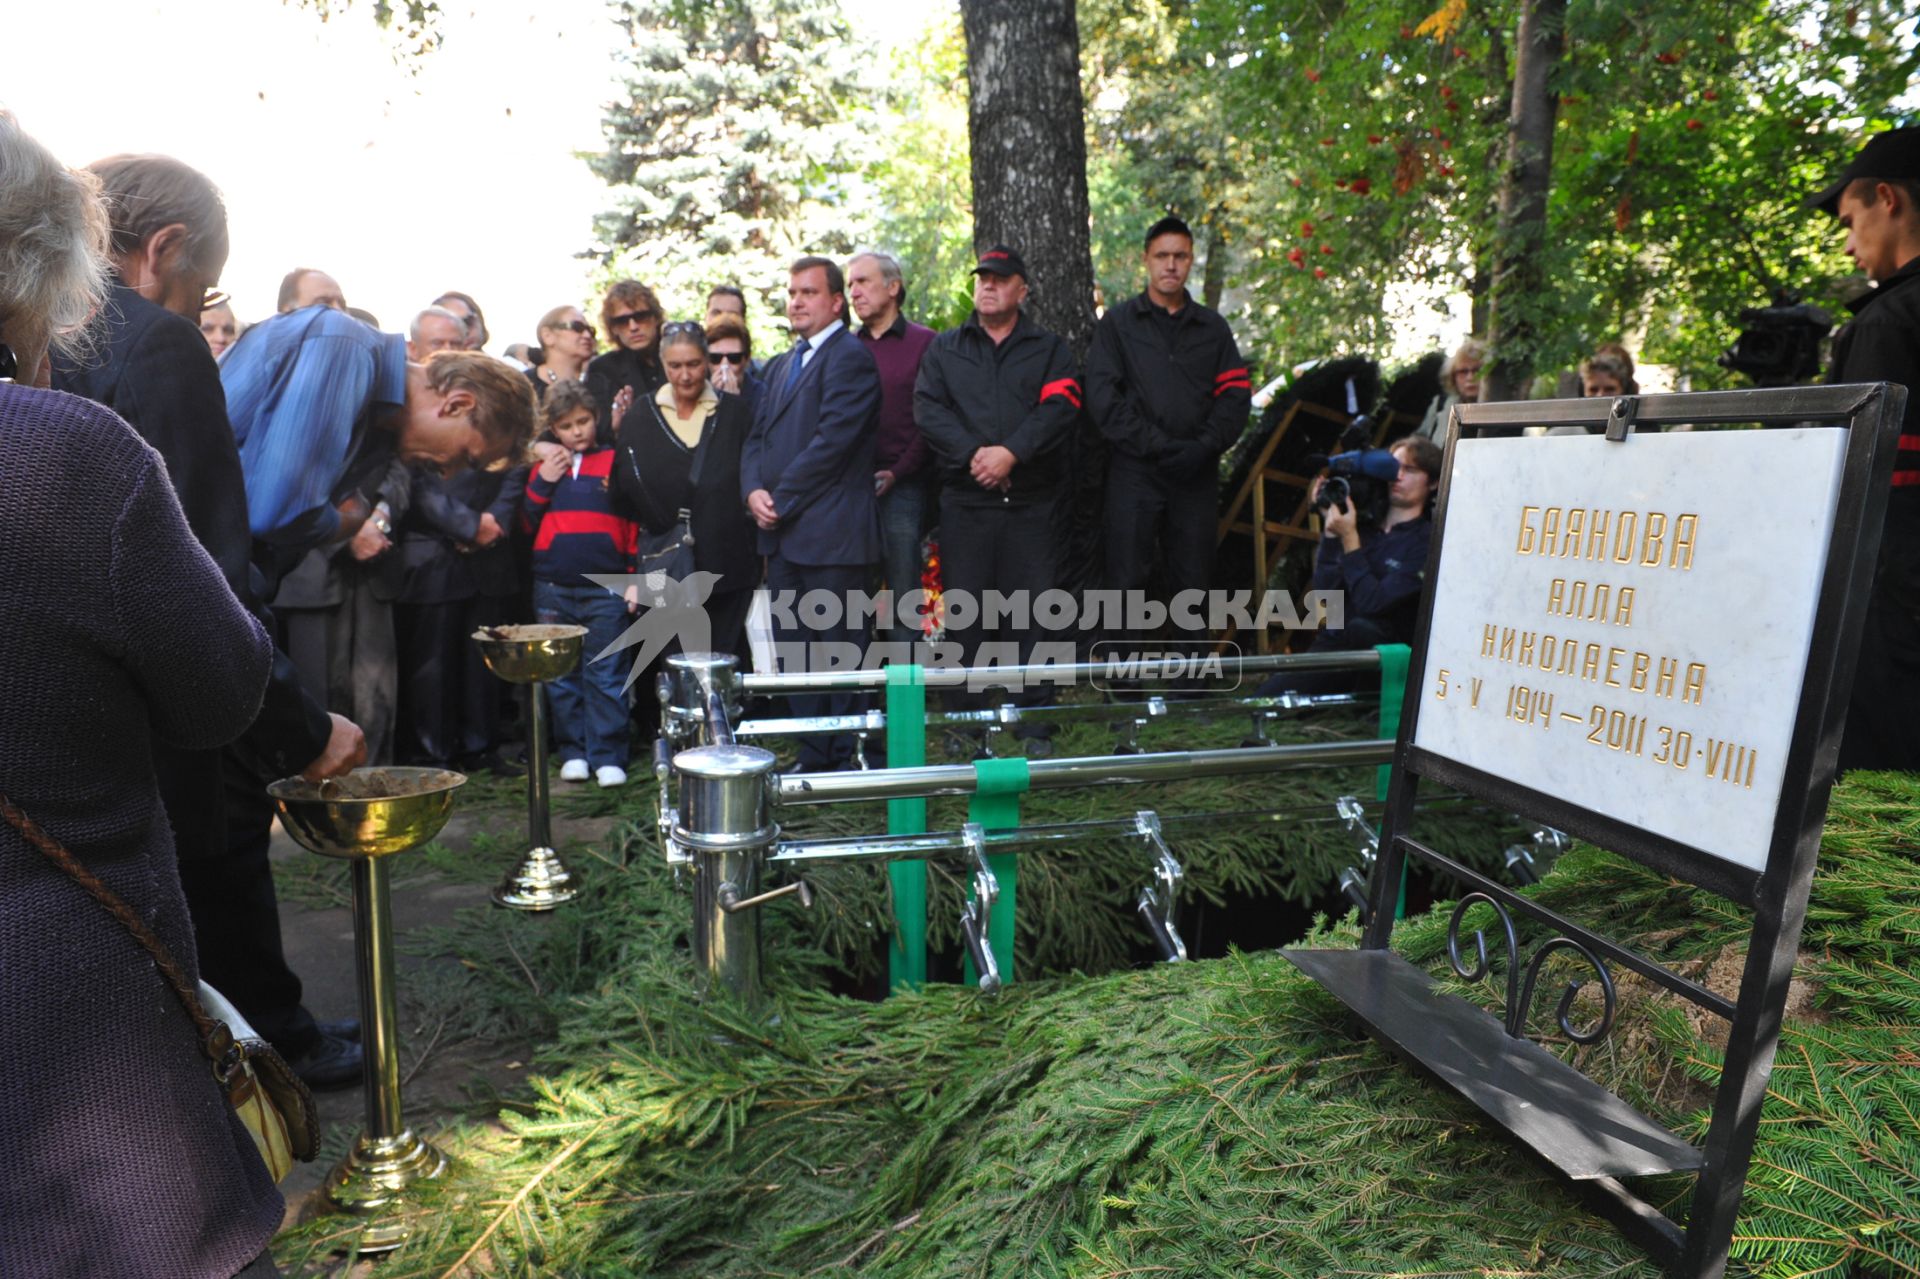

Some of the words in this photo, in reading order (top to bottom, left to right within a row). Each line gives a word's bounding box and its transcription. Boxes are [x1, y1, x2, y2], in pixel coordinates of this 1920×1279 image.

[1517, 506, 1698, 570] БАЯНОВА
[1547, 578, 1635, 626] АЛЛА
[1481, 625, 1706, 705] НИКОЛАЕВНА
